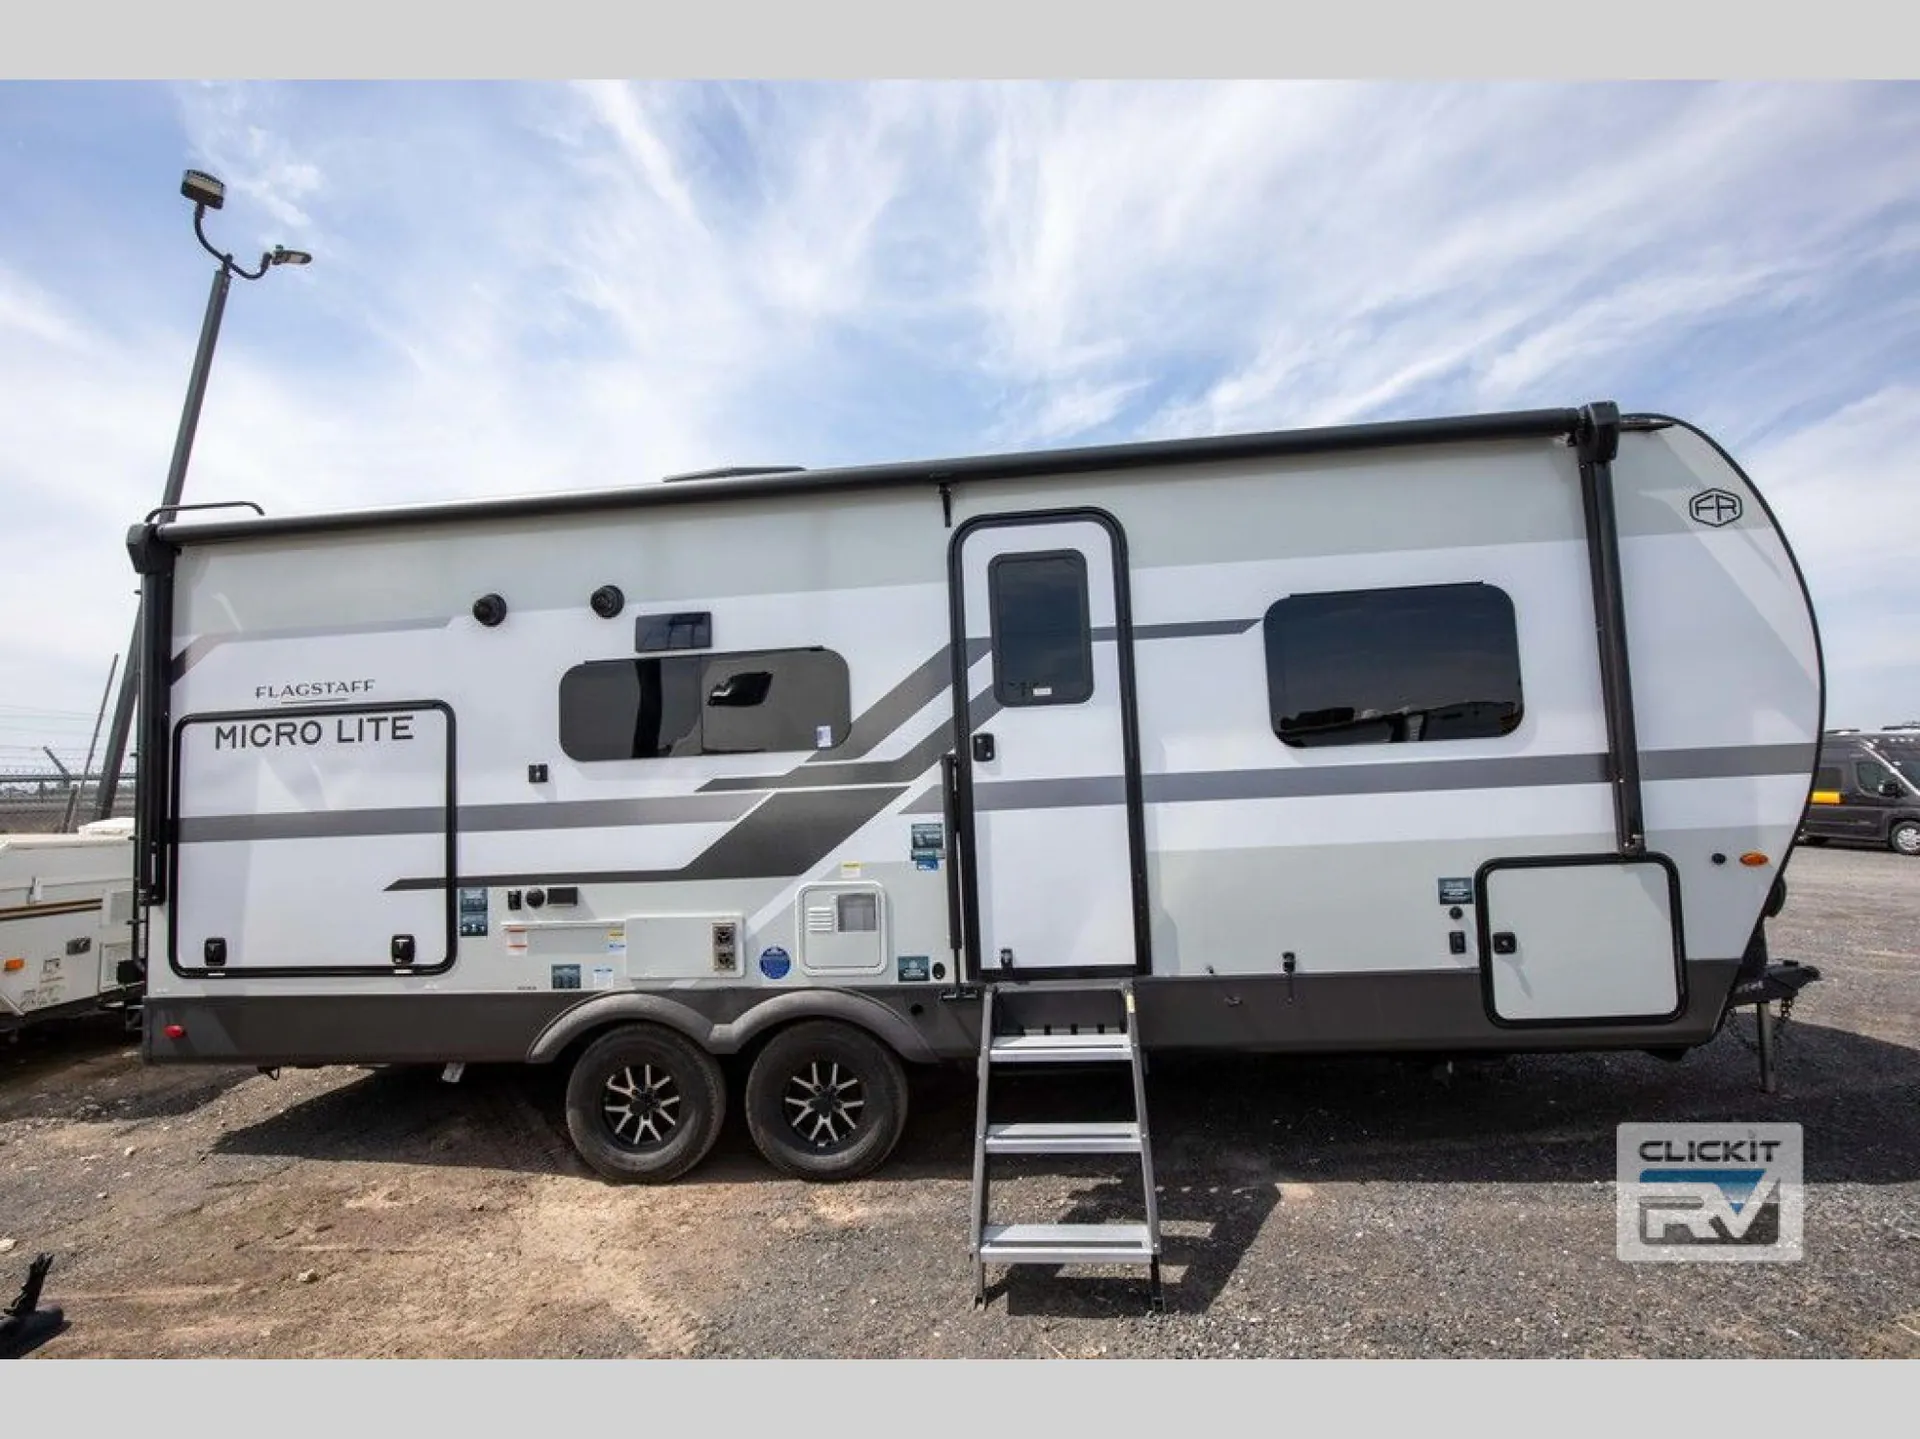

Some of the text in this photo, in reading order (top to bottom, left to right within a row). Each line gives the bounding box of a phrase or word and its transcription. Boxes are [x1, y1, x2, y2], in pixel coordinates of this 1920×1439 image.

[254, 679, 376, 699] FLAGSTAFF
[215, 716, 414, 750] MICRO LITE
